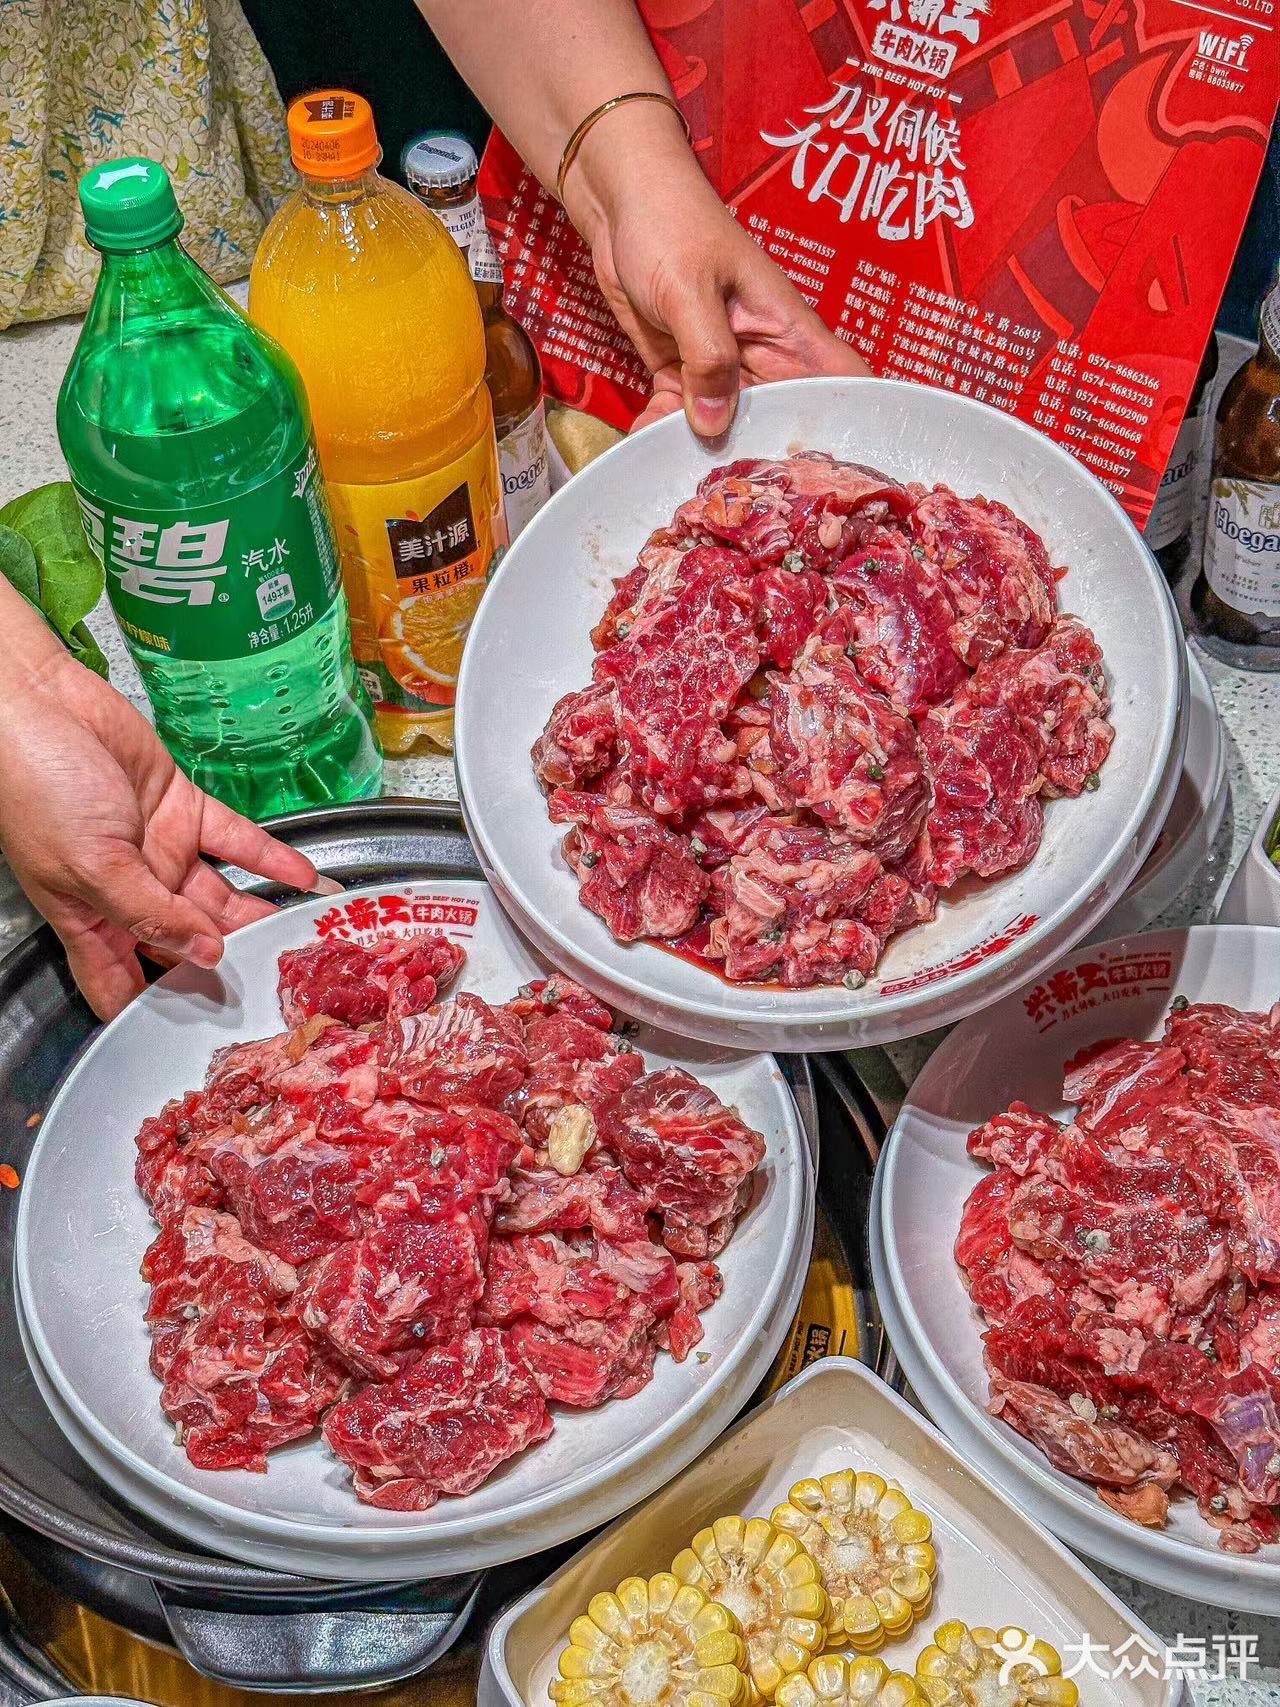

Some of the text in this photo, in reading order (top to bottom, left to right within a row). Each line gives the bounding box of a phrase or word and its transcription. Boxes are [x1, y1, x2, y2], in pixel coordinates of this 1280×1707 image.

[879, 29, 948, 73] 牛肉火锅
[1198, 32, 1252, 66] WiFi
[861, 62, 946, 99] XING BEEF HOT POT
[803, 82, 966, 170] 刀叉伺候
[760, 119, 975, 240] 大口吃肉
[768, 243, 830, 275] 0574-87683283
[774, 227, 836, 259] 0574-86871557
[1081, 371, 1154, 408] 0574-86833733
[1087, 353, 1160, 390] 0574-86862366
[1070, 406, 1142, 444] 0574-86860668
[1075, 389, 1148, 426] 0574-88492909
[1064, 423, 1136, 461] 0574-83073637
[398, 517, 470, 562] 美汁源
[1214, 501, 1280, 553] Hoega
[241, 537, 290, 578] 汽水
[412, 560, 470, 594] 果粒橙
[120, 618, 171, 651] 柠檬味
[416, 906, 473, 925] 牛肉火锅
[1111, 963, 1167, 980] 牛肉火锅
